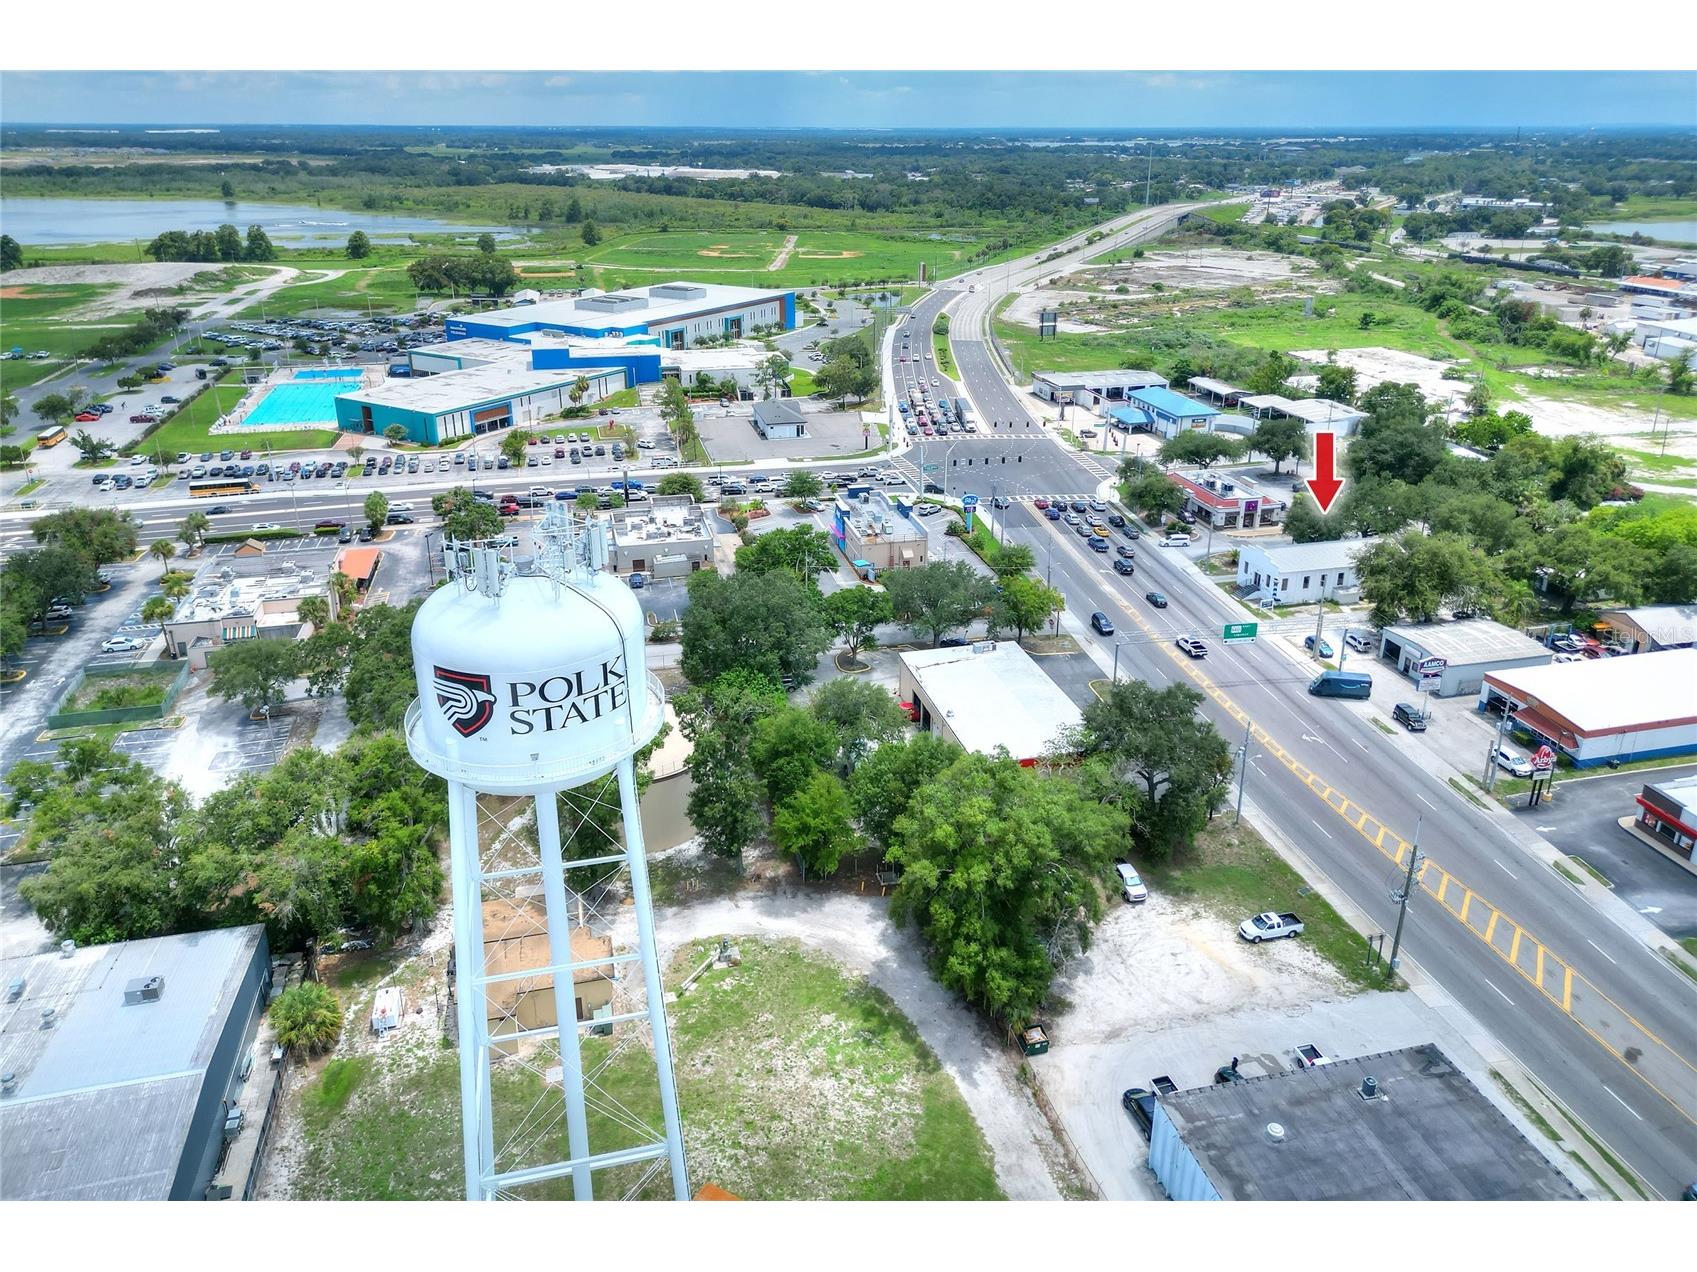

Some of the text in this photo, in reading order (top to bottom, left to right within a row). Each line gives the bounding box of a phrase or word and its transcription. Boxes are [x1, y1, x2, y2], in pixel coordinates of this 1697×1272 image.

[1423, 660, 1445, 668] AAMCO
[506, 655, 625, 708] POLK
[509, 682, 627, 735] STATE
[1533, 755, 1556, 768] Arby's
